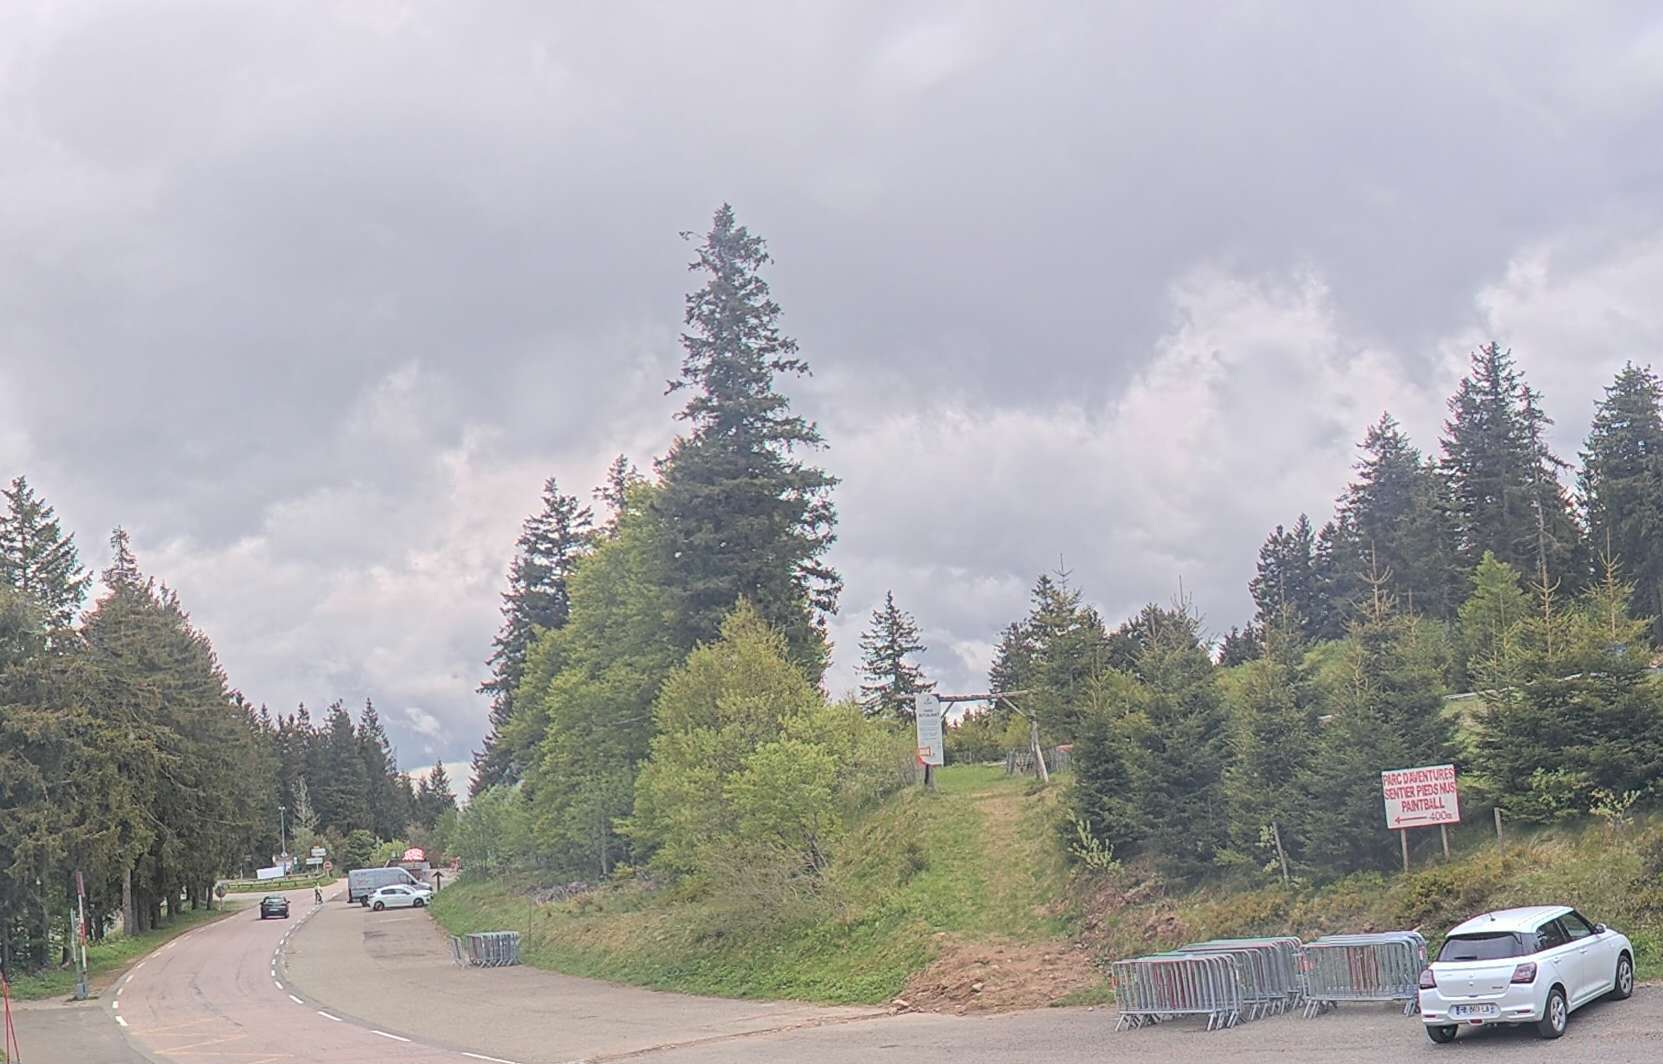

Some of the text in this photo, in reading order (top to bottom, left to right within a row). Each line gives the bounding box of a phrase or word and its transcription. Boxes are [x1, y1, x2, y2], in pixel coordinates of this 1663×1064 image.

[1382, 773, 1402, 786] PARC
[1384, 781, 1456, 800] SENTIER PIEDS NUS
[1402, 797, 1445, 812] PAINTBALL
